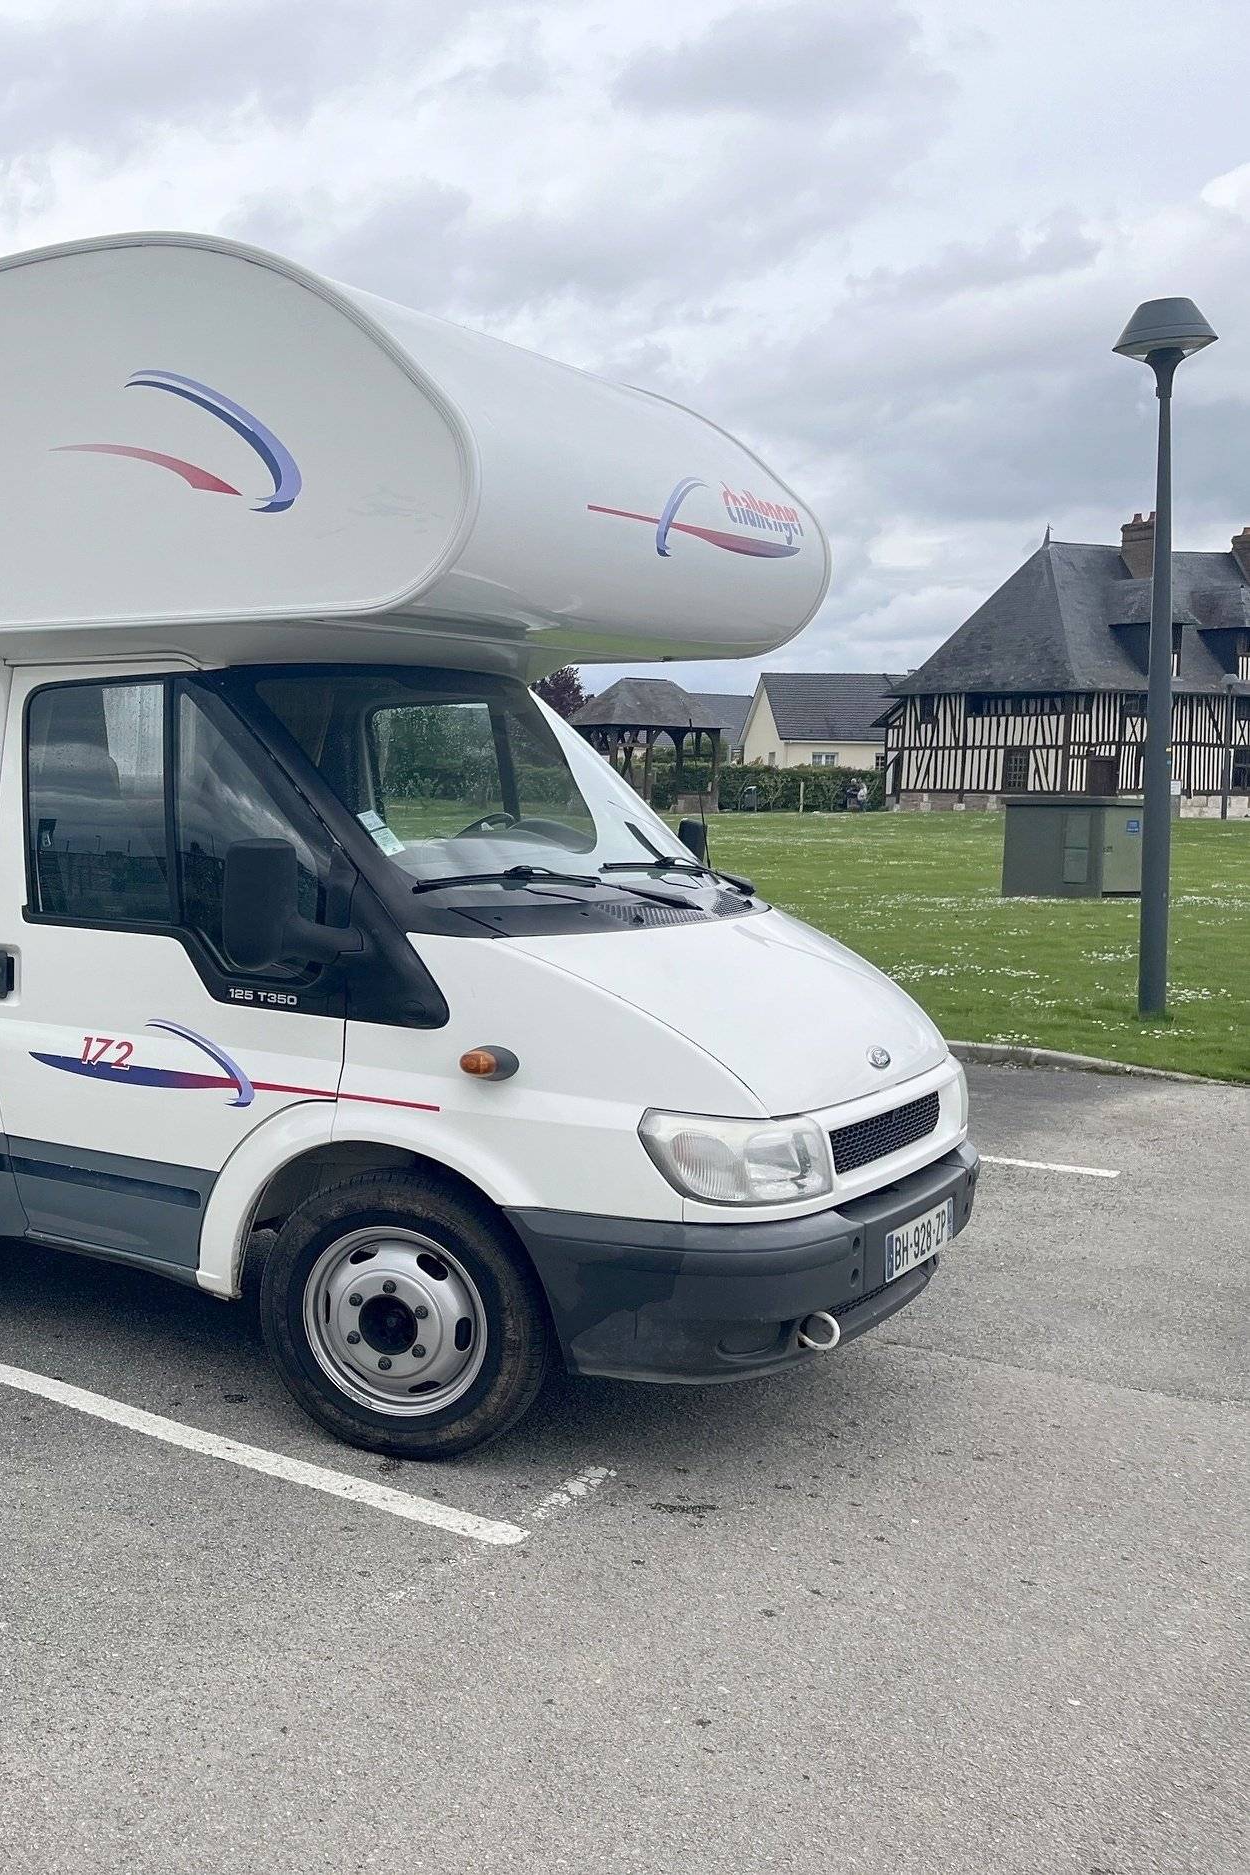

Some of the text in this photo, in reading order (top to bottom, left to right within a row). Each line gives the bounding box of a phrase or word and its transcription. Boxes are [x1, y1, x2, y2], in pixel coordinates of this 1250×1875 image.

[229, 988, 298, 1005] 125 T350
[81, 1036, 133, 1070] 172
[894, 1209, 946, 1271] BH-928-ZP
